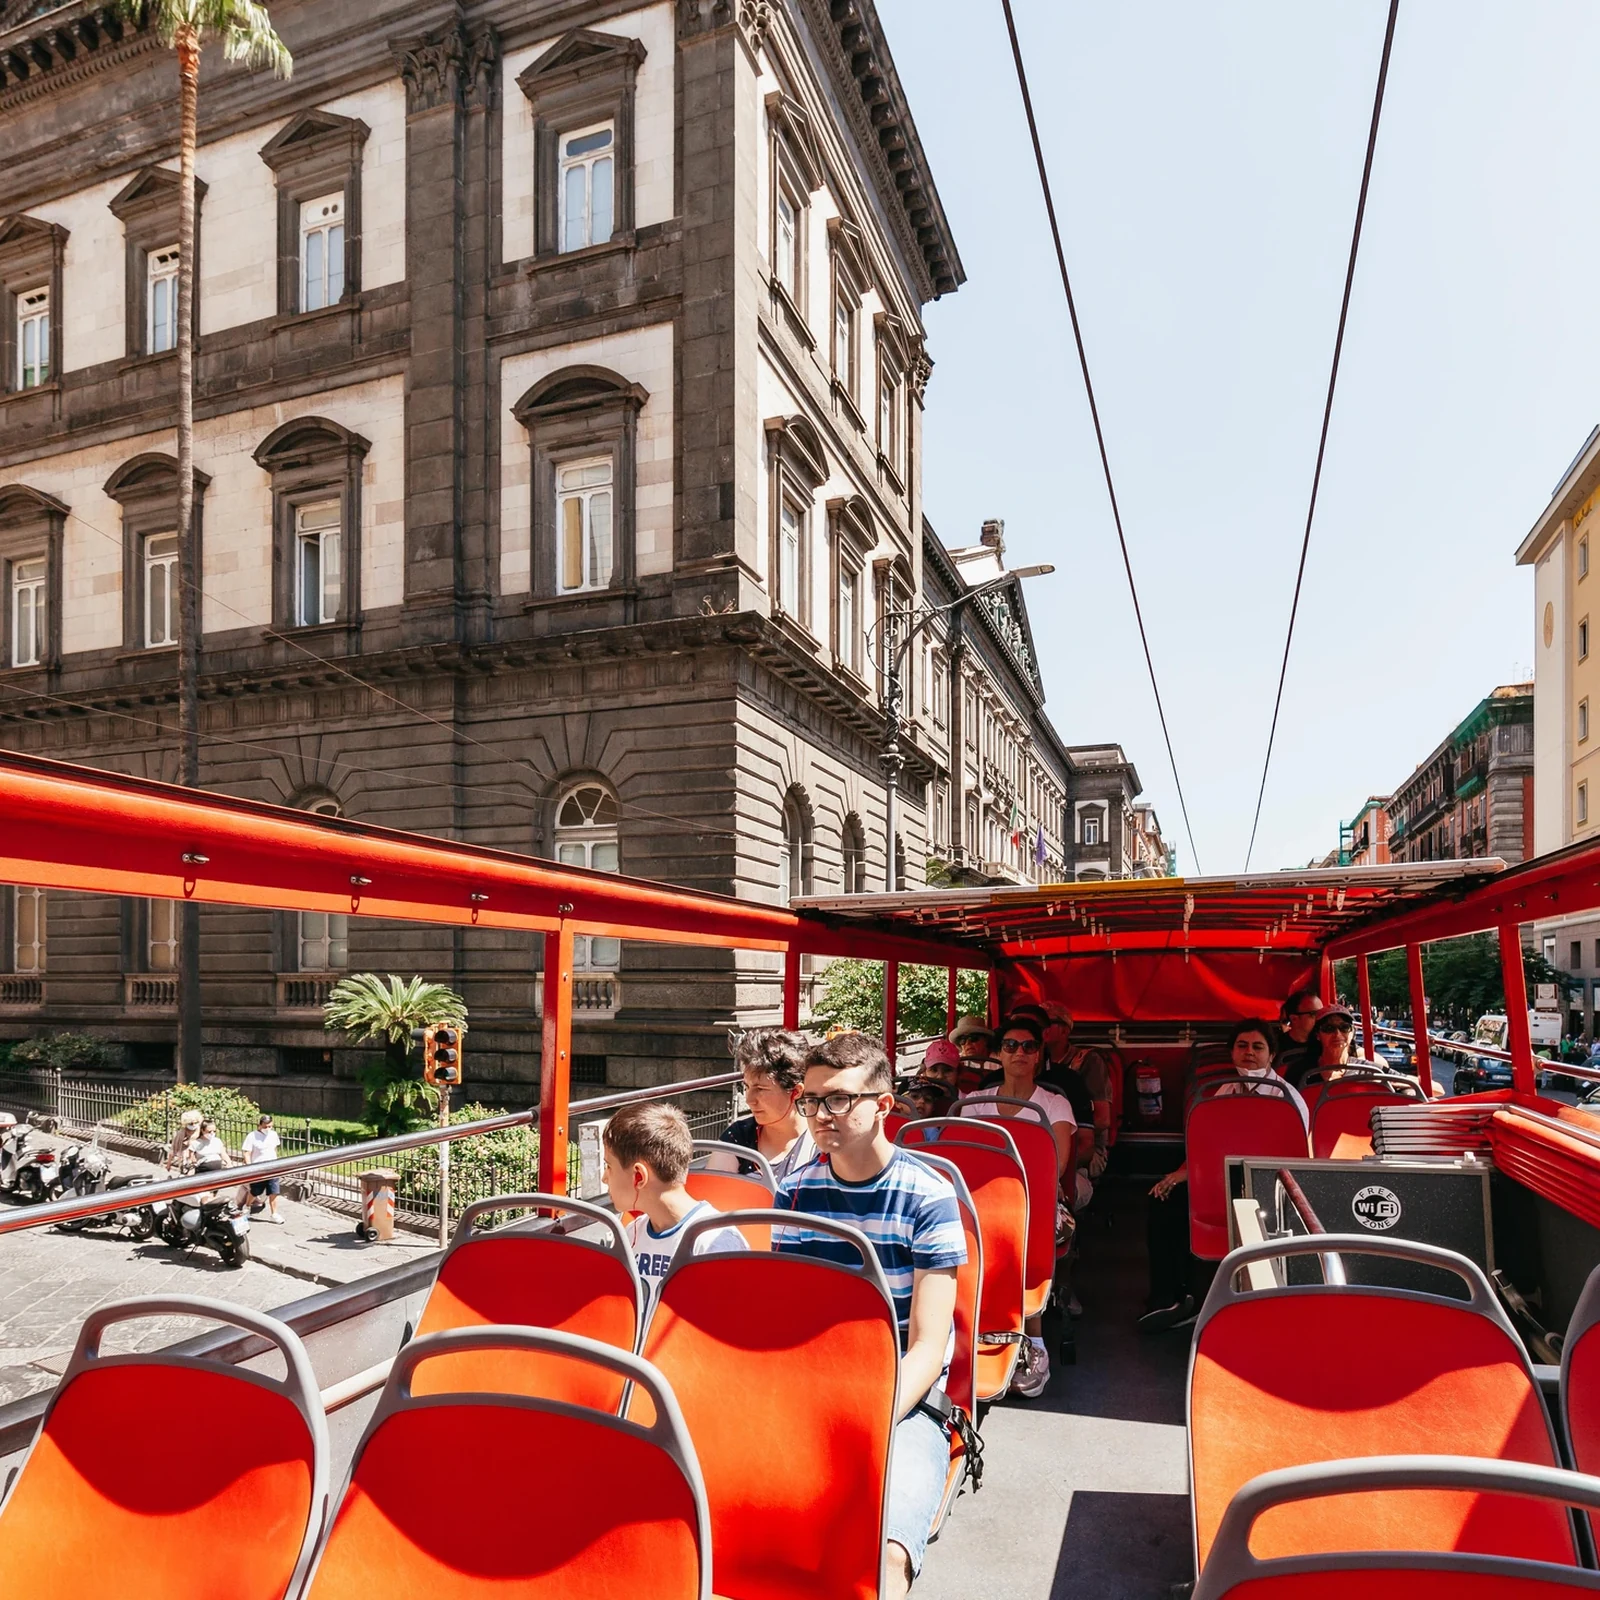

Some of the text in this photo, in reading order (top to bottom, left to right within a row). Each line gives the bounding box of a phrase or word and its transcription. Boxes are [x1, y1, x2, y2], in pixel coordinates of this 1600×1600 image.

[1358, 1187, 1395, 1201] FREE
[1362, 1217, 1392, 1229] ZONE
[635, 1253, 671, 1277] REE
